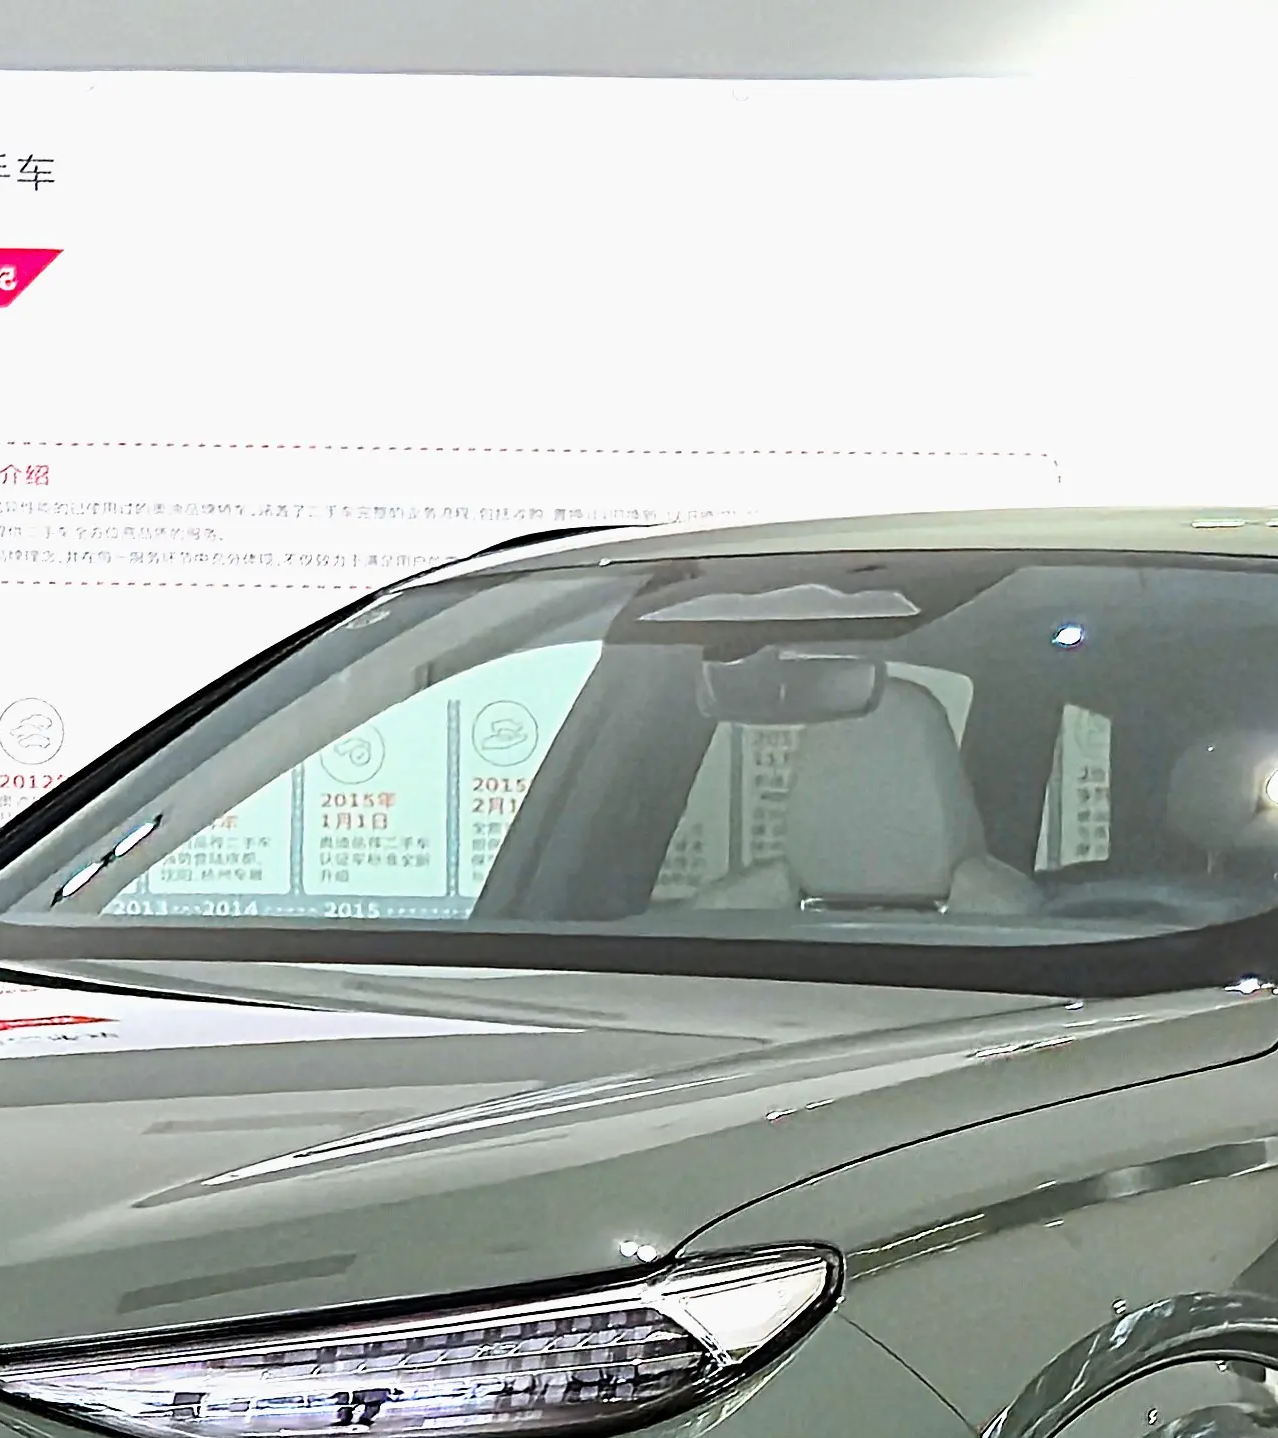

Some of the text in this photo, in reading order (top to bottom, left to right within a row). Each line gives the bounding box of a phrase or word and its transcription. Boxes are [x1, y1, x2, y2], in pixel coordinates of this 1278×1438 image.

[0, 773, 67, 790] 2012
[319, 792, 397, 809] 2015年
[321, 812, 389, 830] 1月1日
[323, 902, 381, 919] 2015
